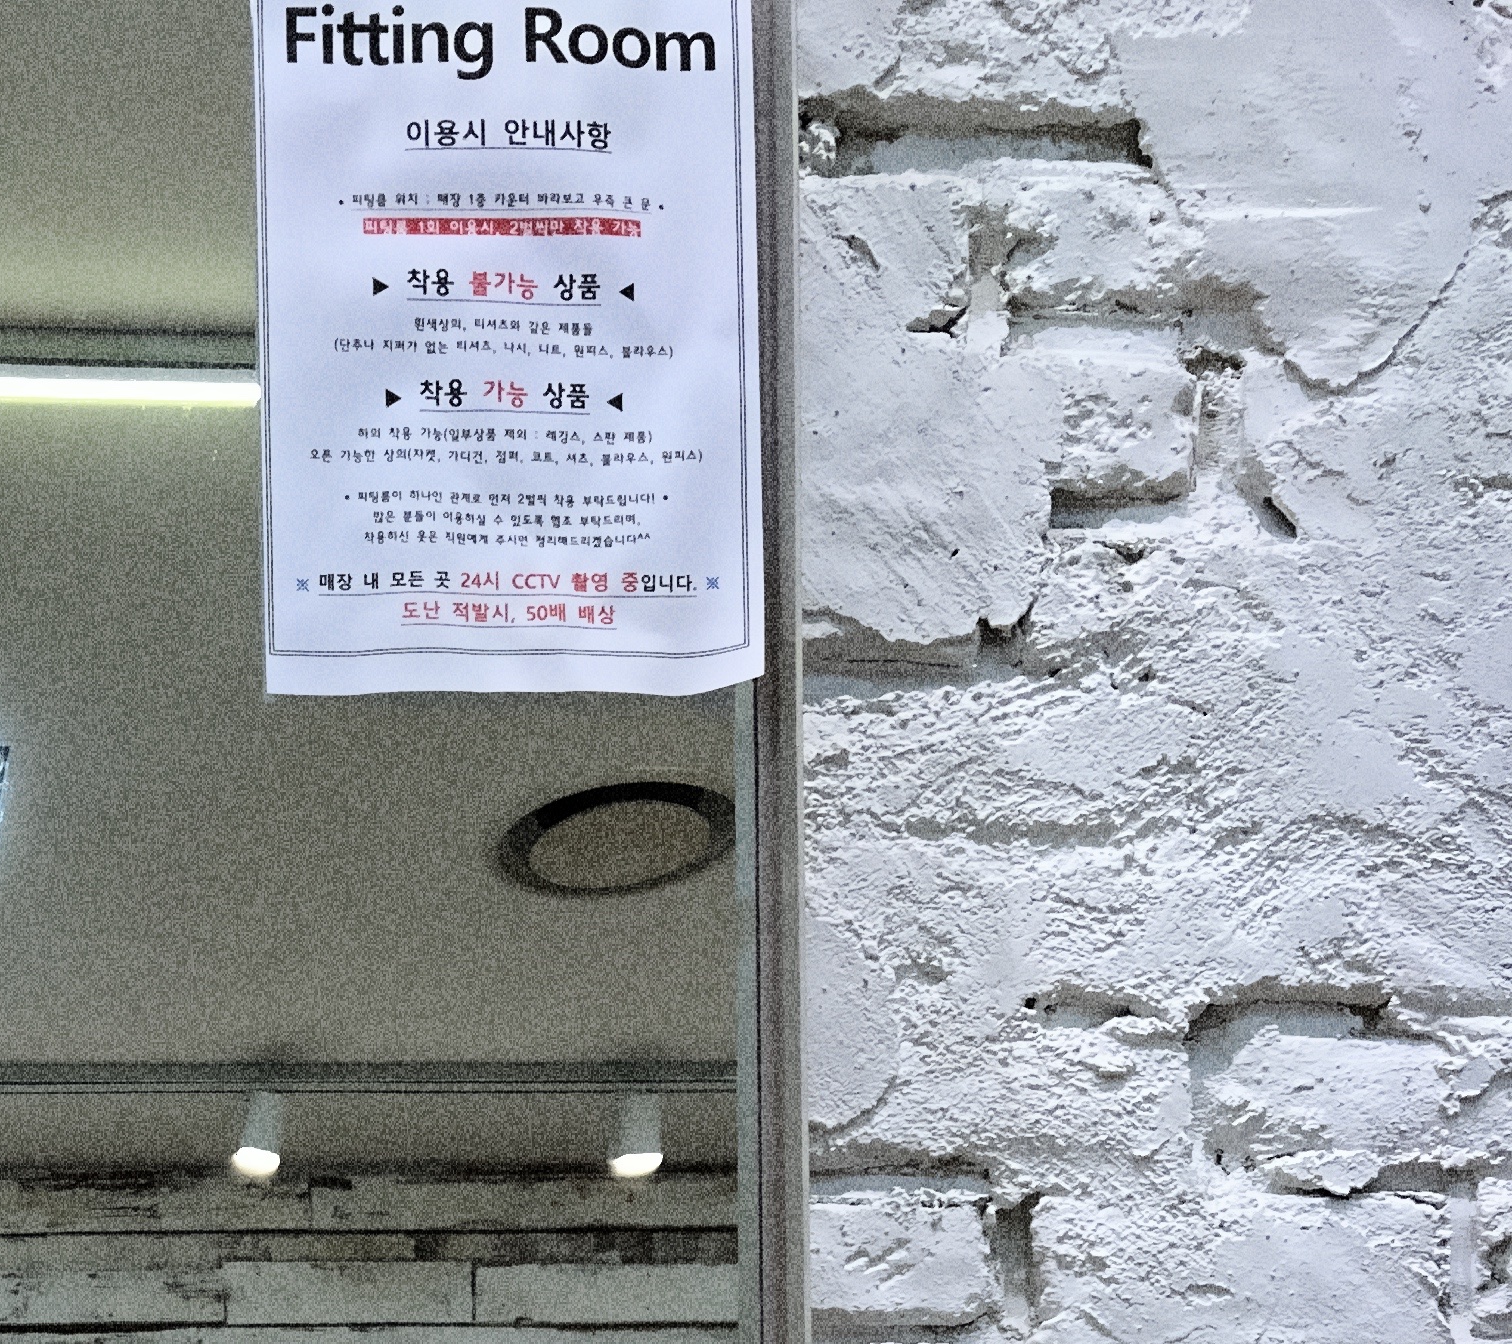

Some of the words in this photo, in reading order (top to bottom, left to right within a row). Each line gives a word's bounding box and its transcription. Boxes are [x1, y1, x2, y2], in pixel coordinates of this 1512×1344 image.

[285, 3, 495, 81] Fitting
[524, 6, 718, 72] Room
[405, 119, 487, 147] 이용시
[504, 119, 612, 149] 안내사항
[396, 193, 418, 205] 위치
[437, 193, 461, 208] 매장
[495, 193, 529, 207] 카운터
[537, 193, 584, 204] 바라보고
[574, 219, 604, 236] 착용
[612, 220, 641, 237] 가능
[406, 268, 455, 297] 착용
[469, 271, 538, 300] 불가능
[553, 273, 601, 301] 상품
[475, 318, 520, 332] 티셔츠와
[529, 321, 551, 335] 같은
[559, 322, 593, 336] 제품들
[383, 339, 417, 352] 지퍼가
[425, 340, 448, 354] 없는
[420, 379, 467, 407] 착용
[483, 380, 528, 409] 가능
[542, 382, 590, 410] 상품
[357, 428, 381, 439] 하의
[389, 427, 412, 441] 착용
[504, 428, 527, 440] 제외
[341, 450, 375, 463] 가능한
[410, 490, 442, 503] 하나인
[450, 492, 482, 504] 관계로
[488, 494, 510, 506] 먼저
[554, 494, 575, 508] 착용
[374, 510, 395, 523] 많은
[403, 510, 436, 522] 분들이
[494, 515, 503, 525] 수
[511, 514, 544, 527] 있도록
[551, 515, 572, 528] 협조
[446, 531, 488, 545] 직원에게
[495, 535, 528, 547] 주시면
[319, 573, 352, 591] 매장
[363, 572, 379, 590] 내
[390, 571, 425, 588] 모든
[434, 571, 450, 589] 곳
[460, 571, 499, 591] 24시
[512, 574, 561, 589] CCTV
[571, 573, 608, 593] 촬영
[621, 572, 697, 593] 중입니다.
[402, 601, 440, 619] 도난
[453, 602, 515, 623] 적발시,
[526, 603, 566, 622] 50배
[578, 605, 615, 624] 배상
